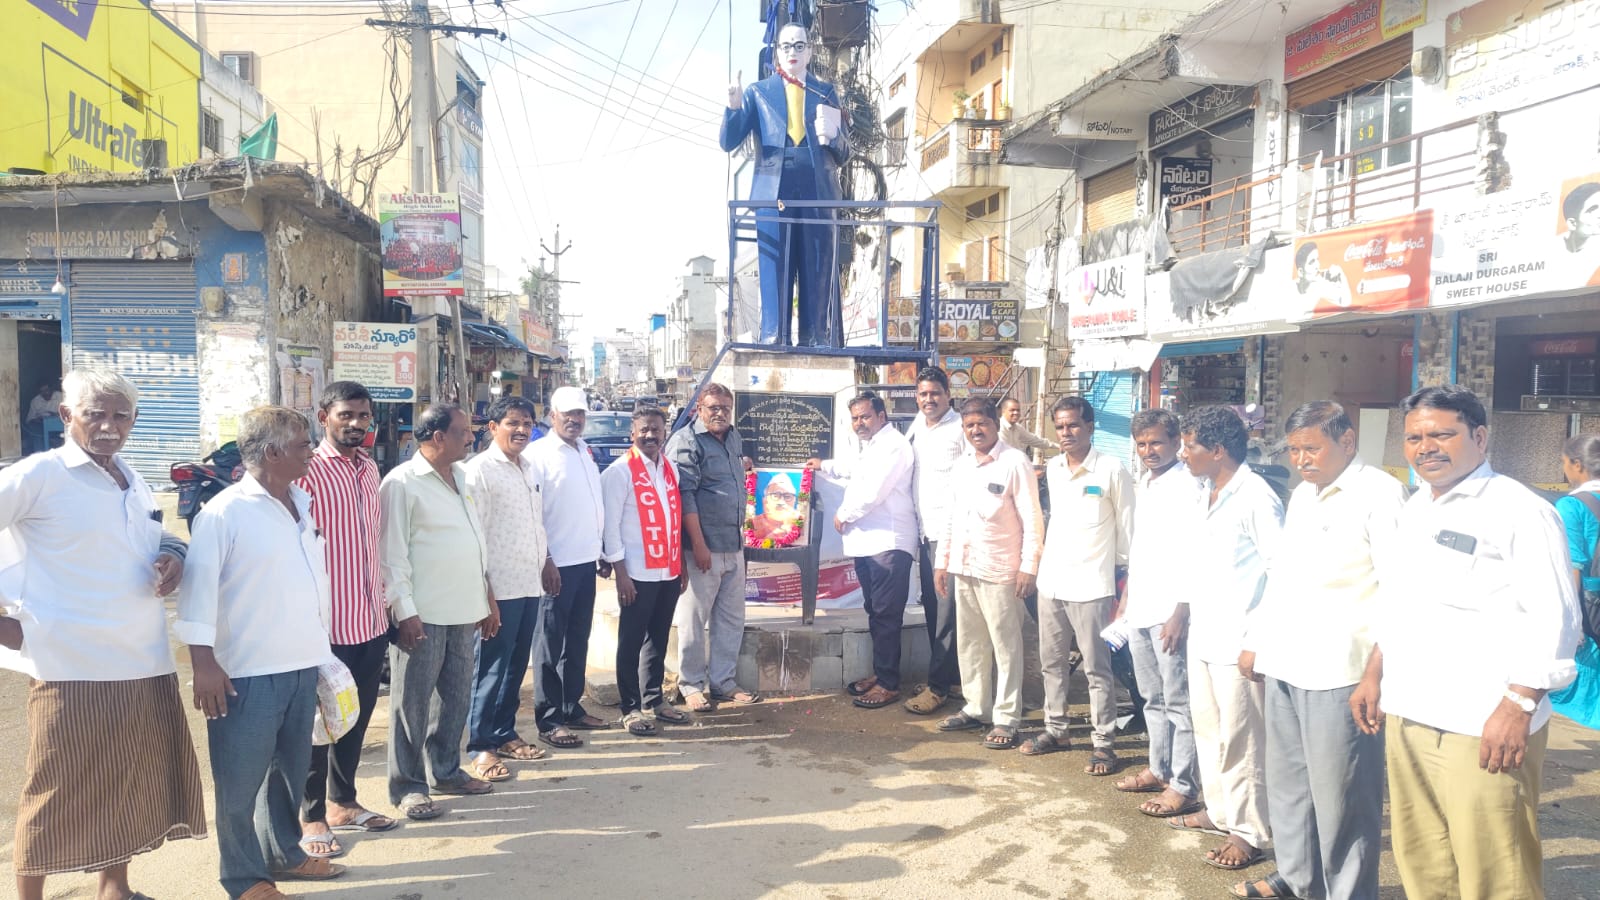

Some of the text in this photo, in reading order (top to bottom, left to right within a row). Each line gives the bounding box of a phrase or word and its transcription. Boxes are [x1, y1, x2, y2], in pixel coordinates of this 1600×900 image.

[69, 90, 144, 168] UltraTe
[30, 230, 156, 247] SRINVASA PAN SHO
[1478, 251, 1499, 264] SRI
[1435, 261, 1546, 286] BALAJI DURGARAM
[1446, 280, 1528, 300] SWEET HOUSE
[640, 491, 665, 559] CITU
